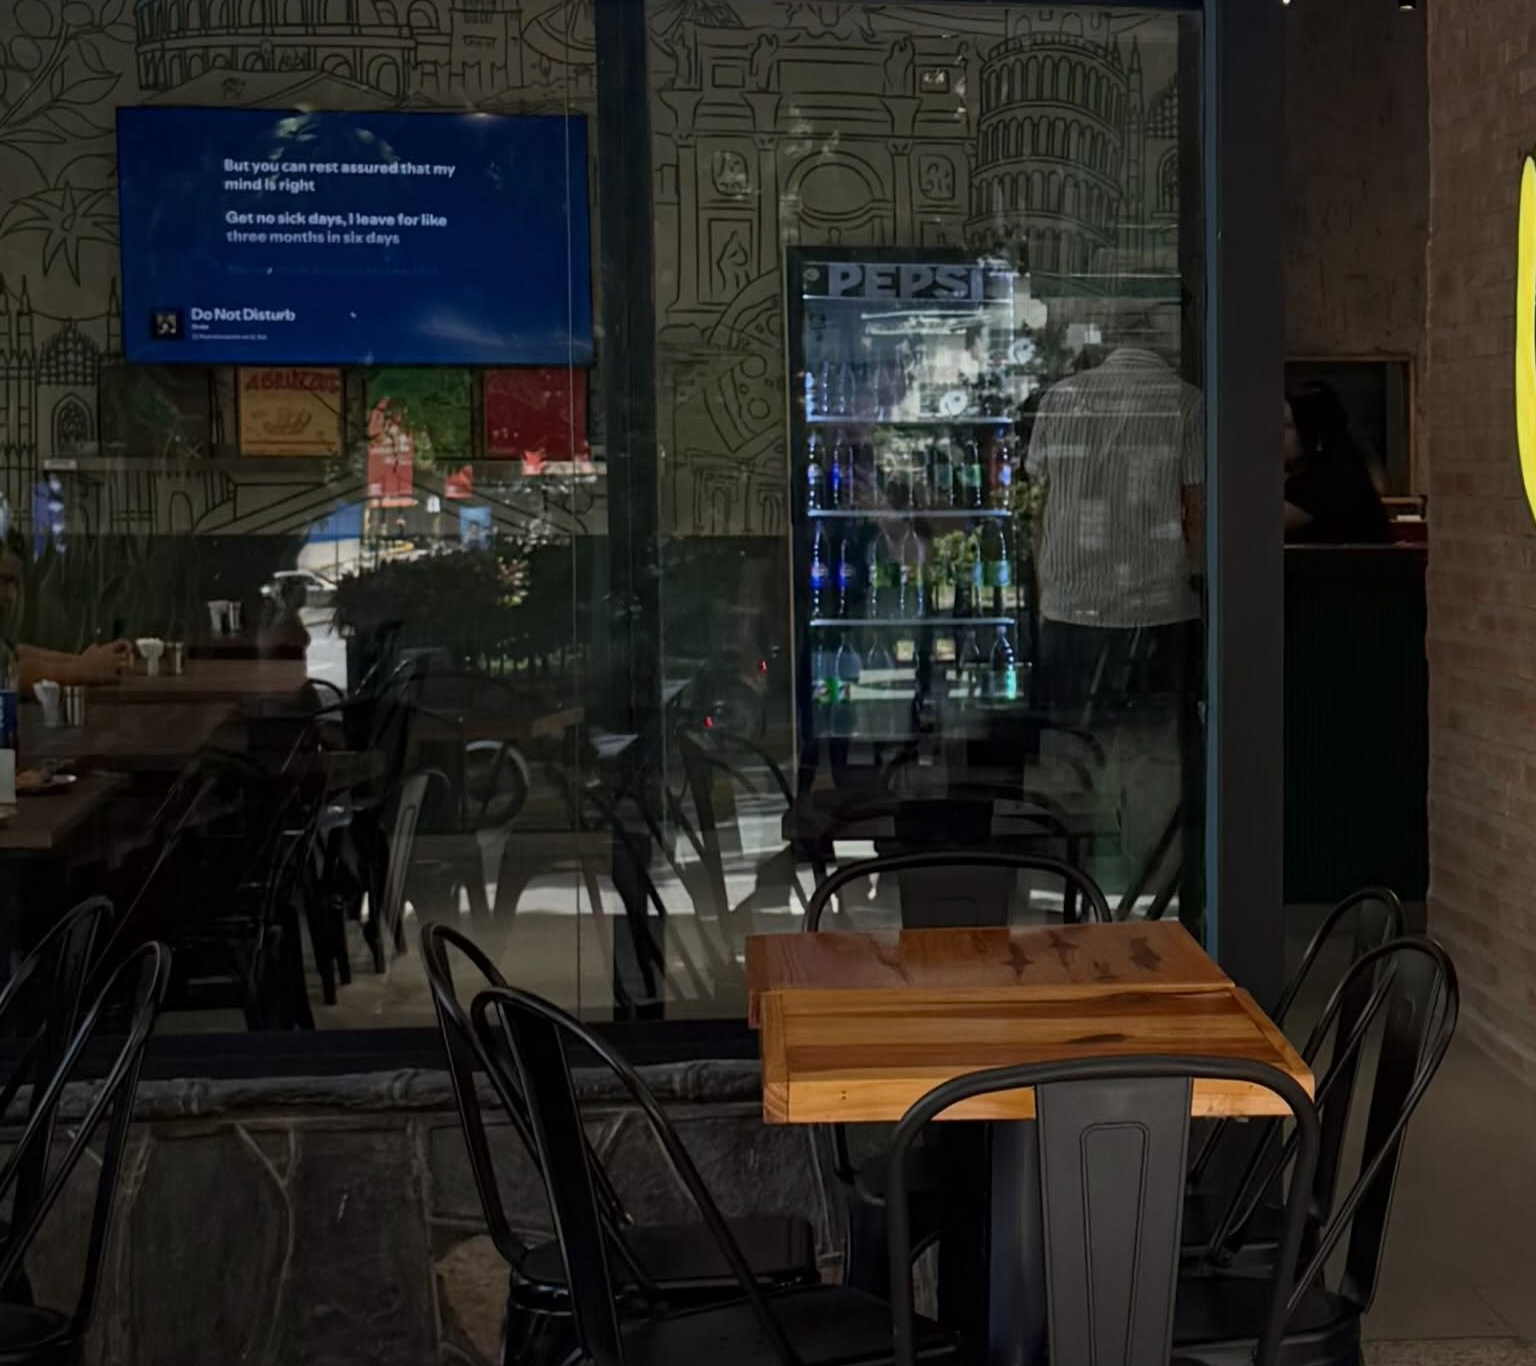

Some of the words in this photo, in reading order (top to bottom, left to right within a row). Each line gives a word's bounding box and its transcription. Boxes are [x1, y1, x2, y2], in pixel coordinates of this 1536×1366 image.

[223, 159, 249, 172] But
[251, 161, 279, 175] you
[281, 162, 307, 173] can
[309, 161, 339, 173] rest
[341, 161, 398, 174] assured
[400, 162, 431, 175] that
[433, 165, 456, 178] my
[224, 178, 262, 191] mind
[264, 179, 277, 191] is
[279, 179, 316, 194] right
[225, 211, 254, 224] Get
[256, 214, 275, 224] no
[277, 212, 306, 225] sick
[308, 212, 347, 228] days,
[349, 213, 354, 225] I
[356, 213, 395, 226] leave
[397, 213, 418, 226] for
[421, 214, 448, 227] like
[226, 231, 267, 243] three
[270, 231, 325, 244] months
[327, 231, 341, 243] in
[343, 232, 363, 244] six
[366, 232, 400, 247] days
[827, 265, 985, 300] PEPSI
[191, 307, 212, 321] Do
[214, 307, 241, 321] Not
[242, 307, 296, 322] Disturb
